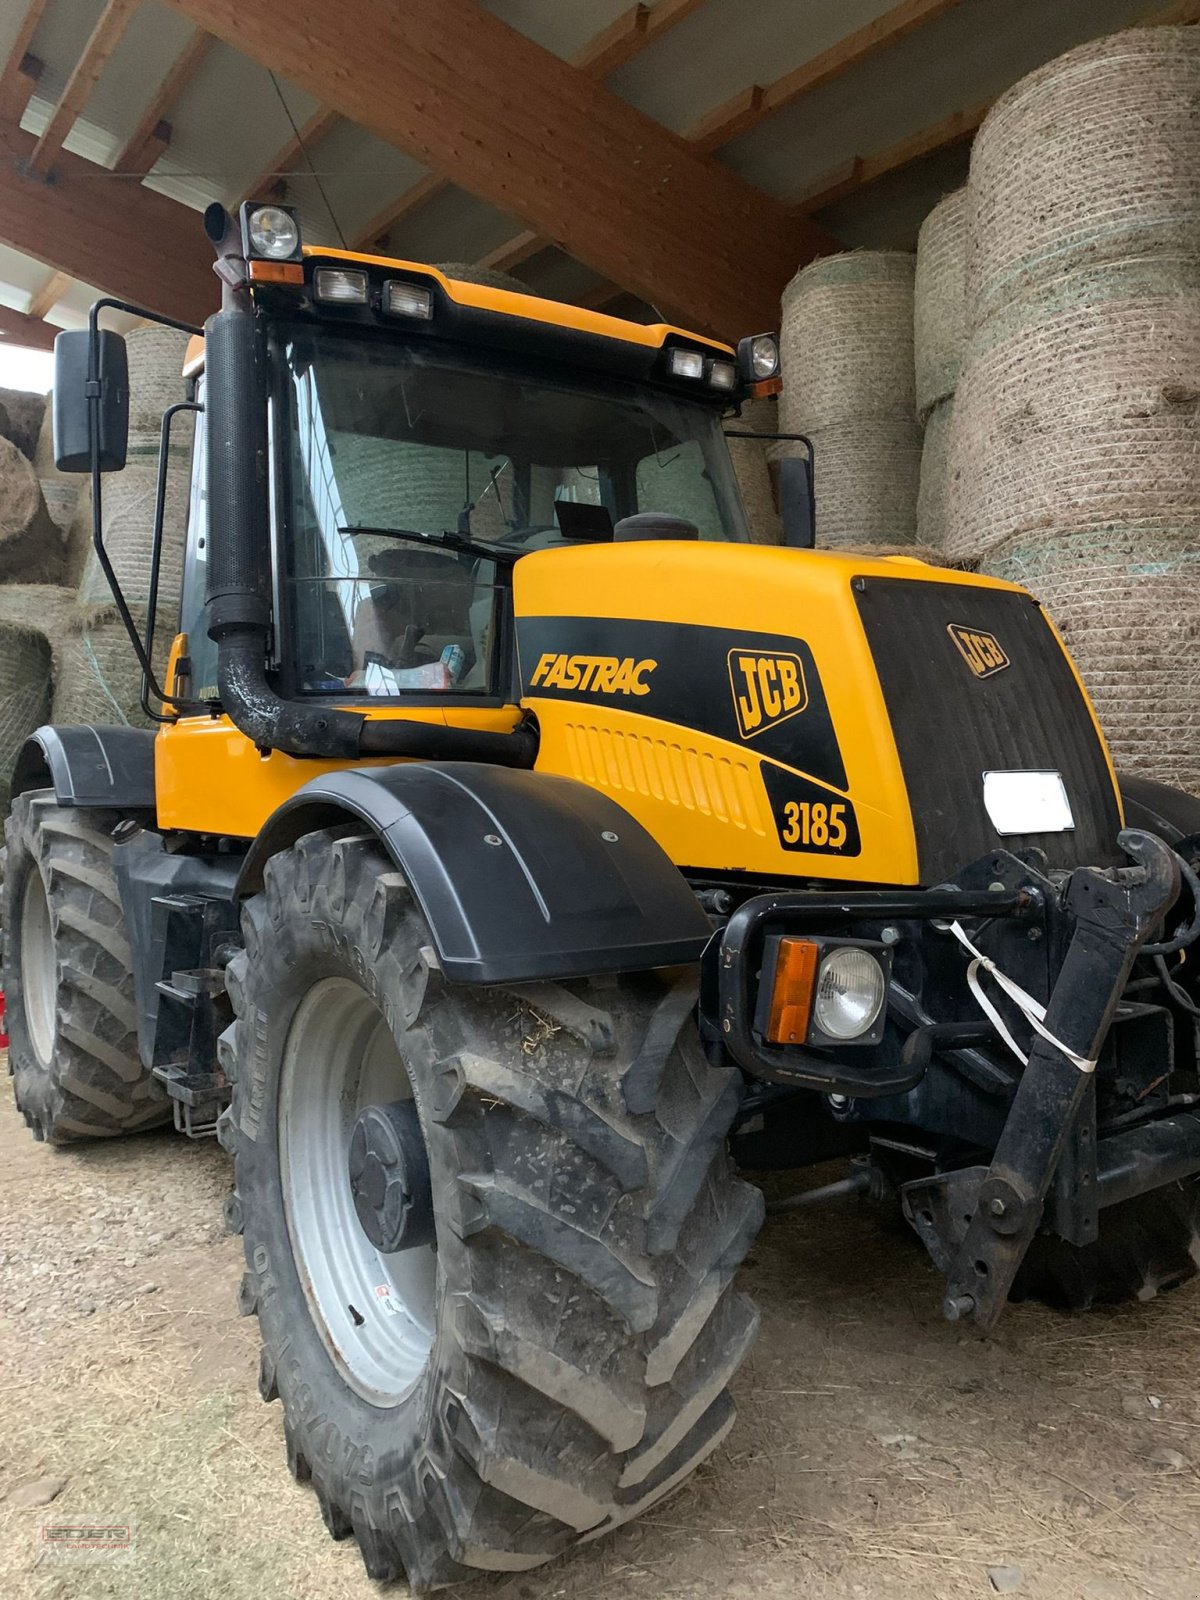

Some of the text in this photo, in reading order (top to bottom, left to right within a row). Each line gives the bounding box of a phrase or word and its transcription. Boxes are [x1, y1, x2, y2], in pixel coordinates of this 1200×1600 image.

[956, 630, 1004, 673] JCB
[530, 653, 658, 696] FASTRAC
[738, 656, 801, 731] JCB
[782, 801, 847, 847] 3185
